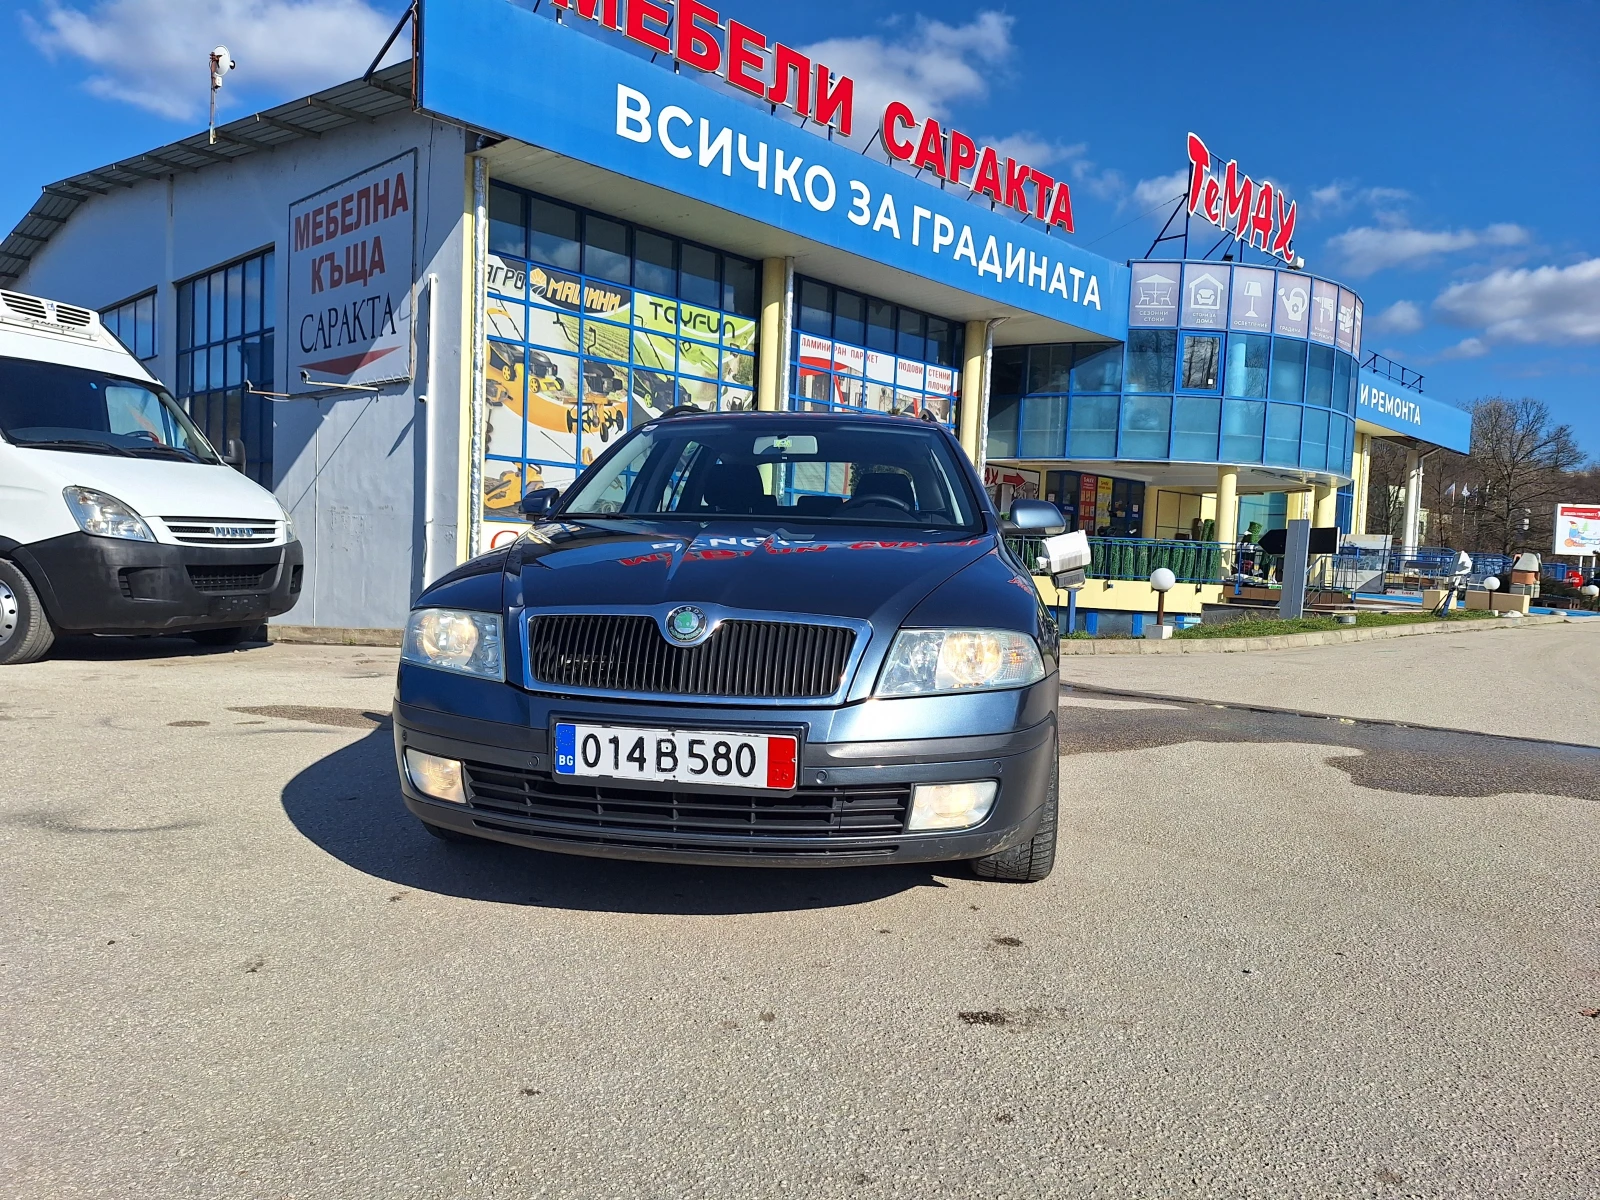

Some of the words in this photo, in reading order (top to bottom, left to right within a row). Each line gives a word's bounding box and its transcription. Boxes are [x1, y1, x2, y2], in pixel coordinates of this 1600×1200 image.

[551, 0, 854, 137] ЕБЕЛИ
[880, 101, 1075, 234] САРАКТА
[294, 172, 409, 252] МЕБЕЛНА
[616, 83, 837, 212] ВСИЧКО
[847, 180, 900, 240] ЗА
[911, 205, 1102, 311] ГРАДИНАТА
[311, 235, 386, 295] КЪЩА
[546, 277, 621, 313] МАШИНИ
[24, 317, 76, 331] ZANOTTI
[300, 292, 397, 354] САРАКТА
[801, 337, 847, 356] ЛАМИНИРАН
[850, 349, 879, 365] ПАРКЕТ
[898, 361, 923, 375] ПОДОВИ
[928, 368, 951, 381] СТЕННИ
[927, 380, 951, 393] ПЛОЧКИ
[1360, 383, 1369, 406] И
[1370, 388, 1421, 426] РЕМОНТА
[558, 754, 575, 767] BG
